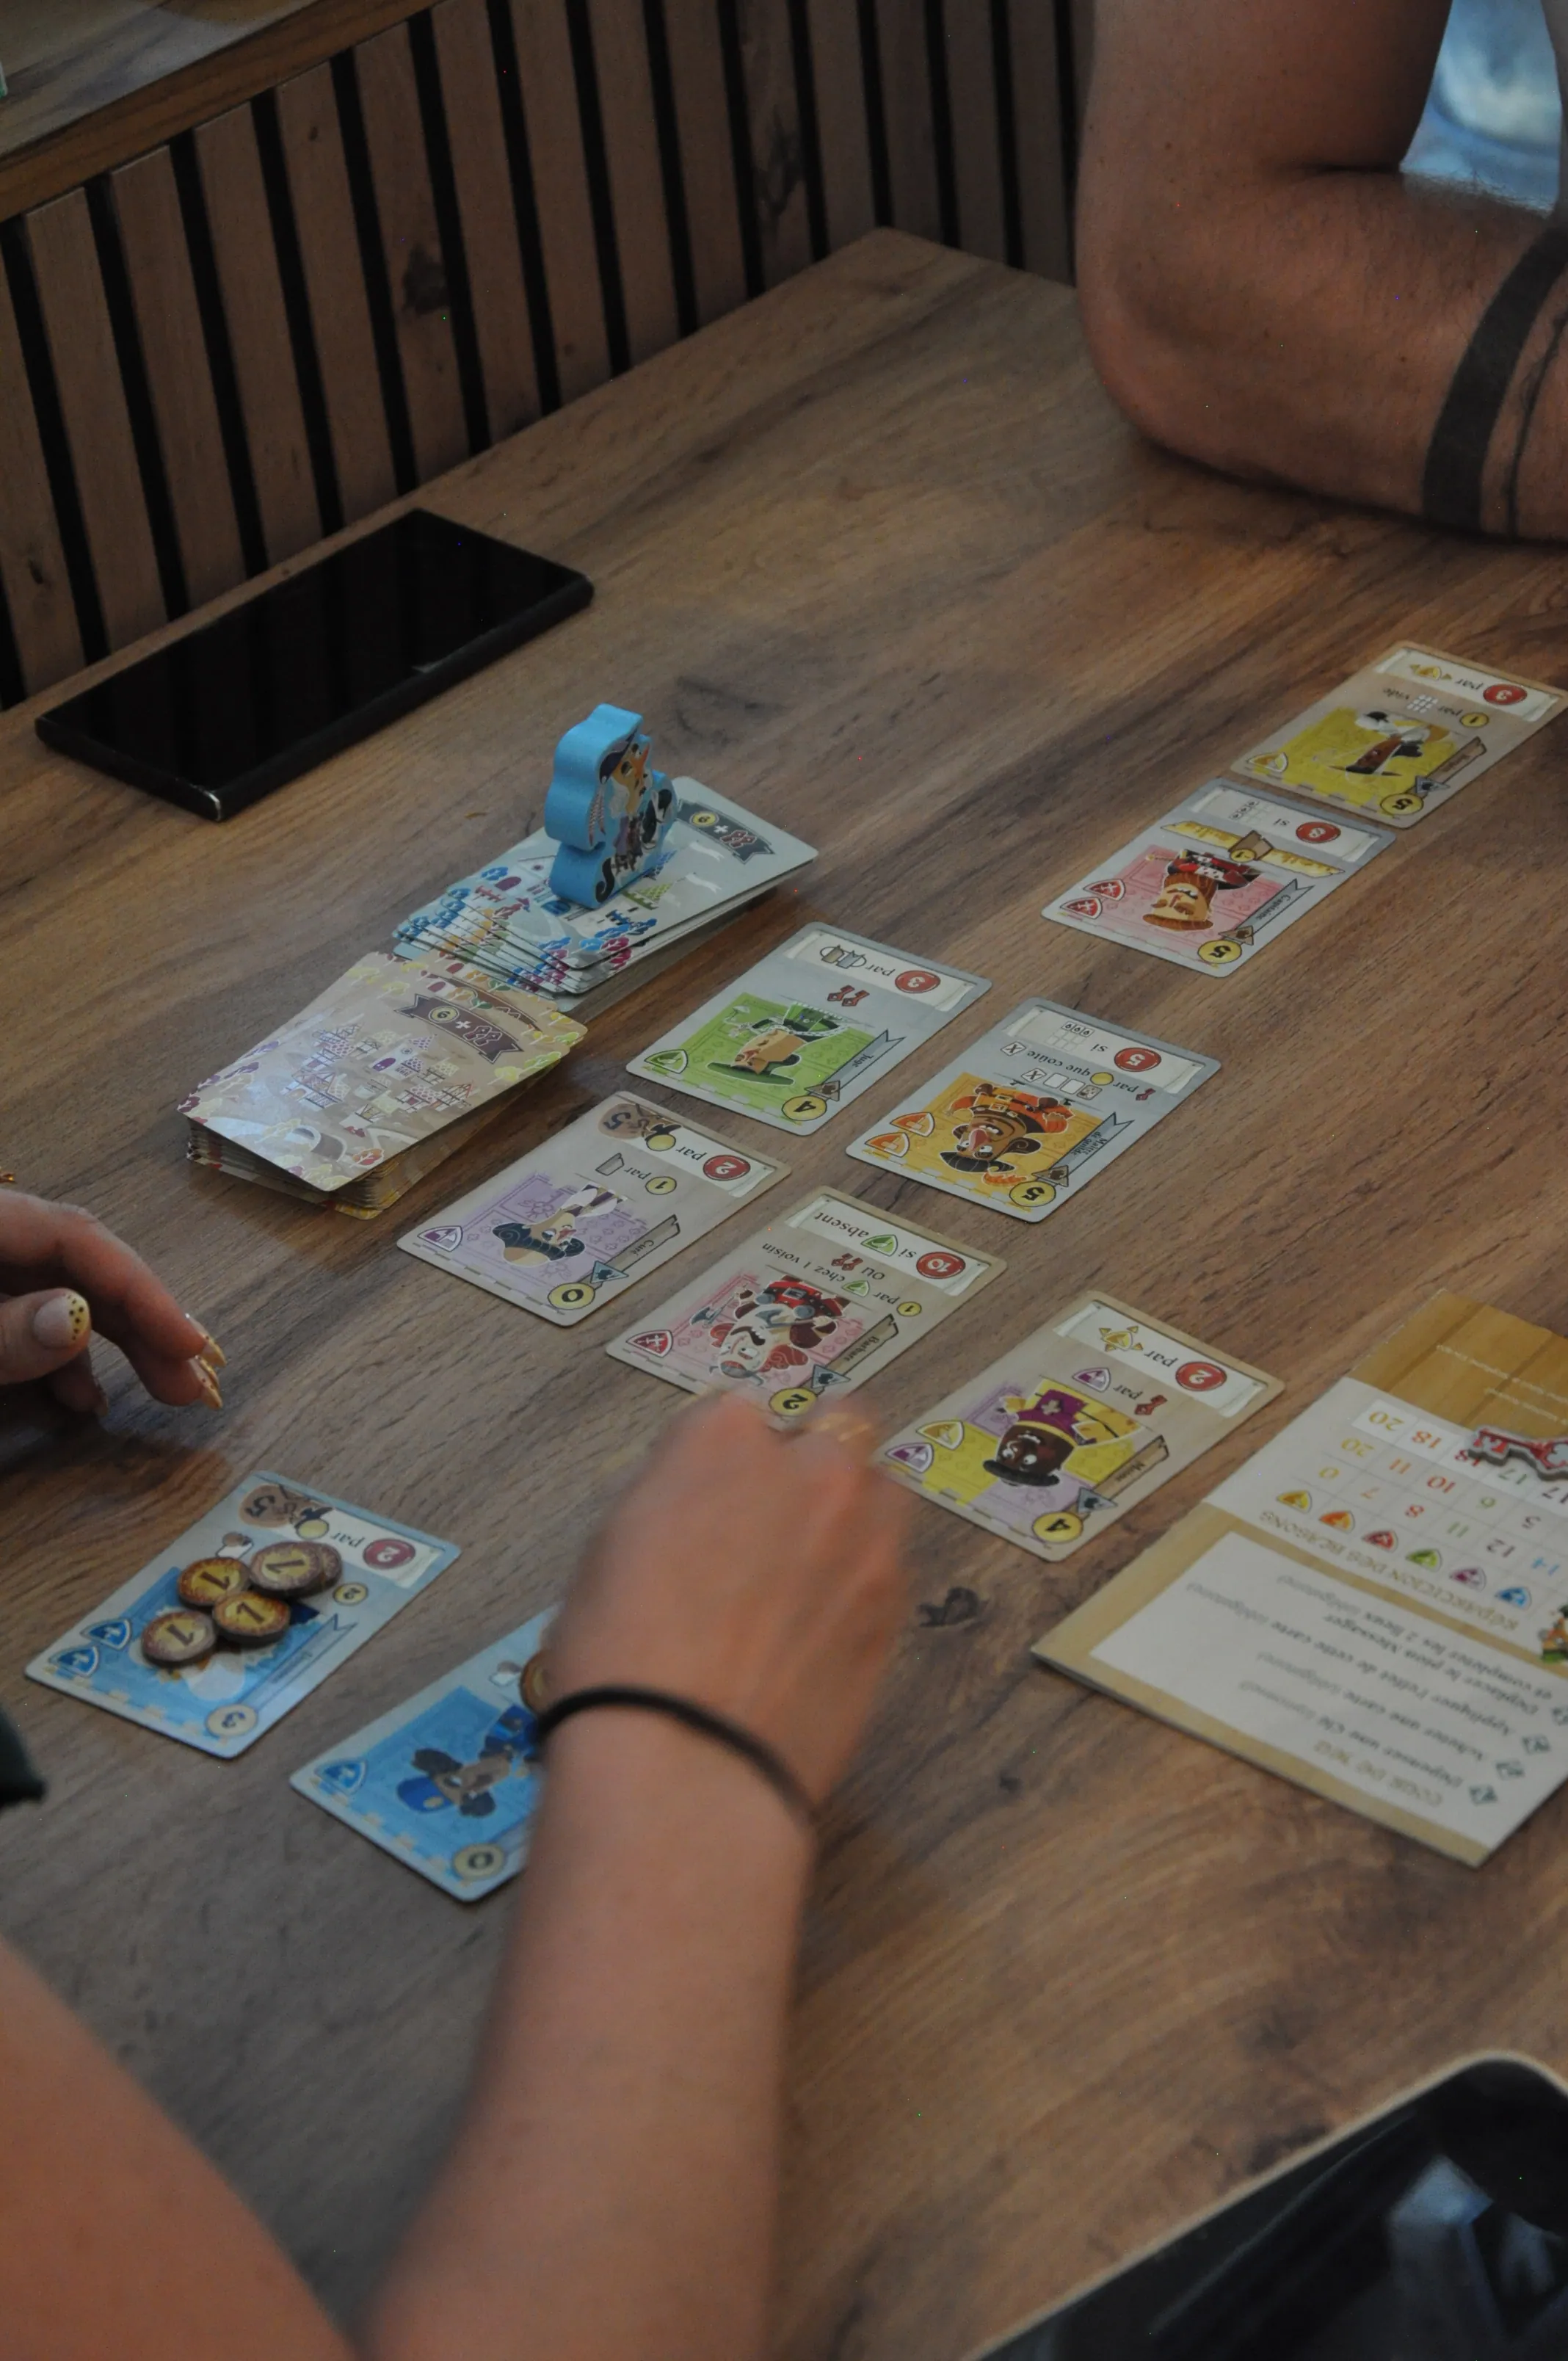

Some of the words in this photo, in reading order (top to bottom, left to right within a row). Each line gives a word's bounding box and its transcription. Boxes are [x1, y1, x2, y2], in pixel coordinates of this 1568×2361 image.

[1454, 678, 1484, 691] par
[1392, 797, 1413, 810] 5
[1274, 818, 1291, 827] si
[1255, 893, 1292, 921] Capitaine
[1209, 944, 1233, 958] 5
[865, 964, 896, 977] par
[907, 976, 926, 988] 3
[1090, 1043, 1108, 1053] si
[852, 1053, 875, 1068] Juge
[1027, 1051, 1064, 1068] coûte
[1125, 1053, 1146, 1067] 5
[1065, 1065, 1091, 1077] que
[1112, 1081, 1140, 1093] par
[793, 1100, 817, 1113] 4
[675, 1145, 708, 1161] par
[624, 1167, 653, 1181] par
[714, 1161, 738, 1175] 2
[654, 1180, 669, 1190] 1
[1021, 1186, 1046, 1201] 5
[814, 1211, 870, 1239] absent
[630, 1238, 655, 1258] Curé
[762, 1242, 800, 1264] voisin
[898, 1248, 918, 1259] si
[926, 1258, 952, 1272] 10
[813, 1265, 846, 1283] chez
[562, 1288, 584, 1302] 0
[872, 1291, 901, 1305] par
[846, 1335, 881, 1363] Barbare
[1143, 1350, 1179, 1368] par
[1188, 1369, 1213, 1384] 2
[1112, 1385, 1144, 1401] par
[783, 1393, 809, 1410] 2
[1368, 1411, 1407, 1432] 20
[1412, 1429, 1442, 1450] 18
[1340, 1437, 1375, 1459] 20
[1388, 1457, 1413, 1476] 11
[1497, 1467, 1531, 1486] 17
[1426, 1475, 1457, 1495] 10
[1476, 1496, 1498, 1510] 6
[1404, 1504, 1426, 1519] 8
[1045, 1517, 1072, 1533] 4
[1446, 1520, 1470, 1539] 11
[1521, 1515, 1542, 1531] 5
[330, 1531, 366, 1549] par
[375, 1545, 402, 1564] 2
[1486, 1538, 1517, 1559] 12
[265, 1558, 305, 1575] 1
[1530, 1556, 1562, 1577] 14
[199, 1570, 231, 1592] 1
[236, 1601, 266, 1624] 1
[165, 1623, 195, 1647] 1
